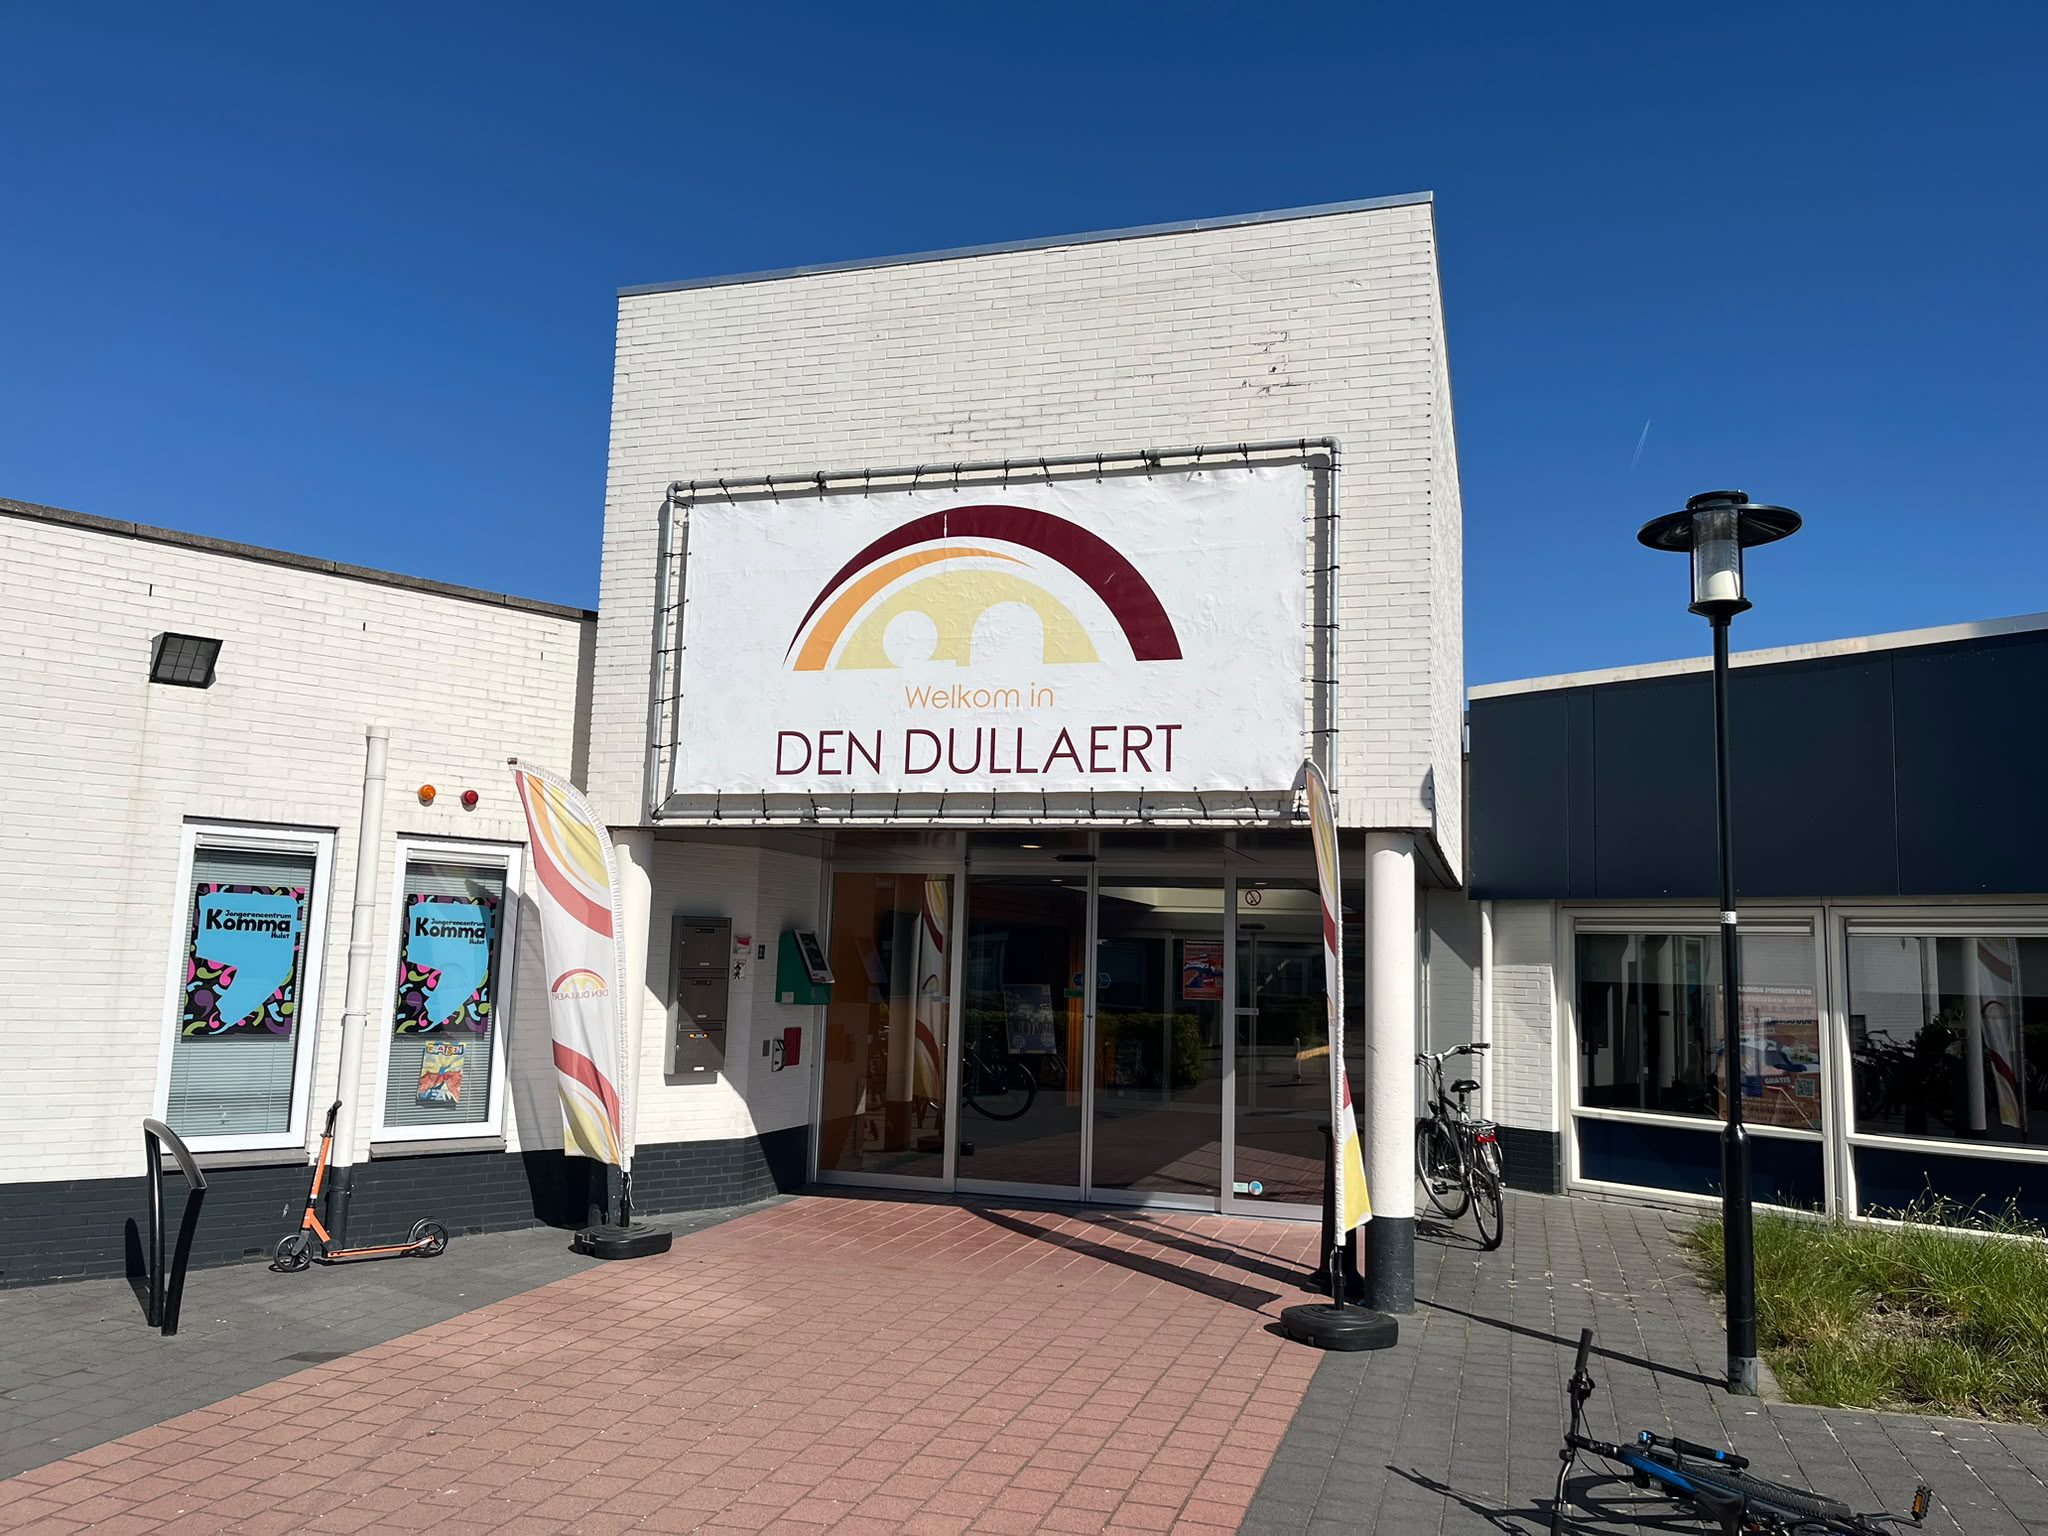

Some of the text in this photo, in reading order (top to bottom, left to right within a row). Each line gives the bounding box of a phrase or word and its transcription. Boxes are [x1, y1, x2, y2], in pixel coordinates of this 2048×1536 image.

[905, 682, 1054, 709] Welkom in
[776, 724, 1182, 776] DEN DULLAERT
[206, 908, 291, 932] Komma
[225, 909, 292, 919] Jongerencentrum
[431, 918, 487, 927] Jongerencentrum
[271, 931, 290, 939] Hulst
[415, 917, 486, 939] Komma
